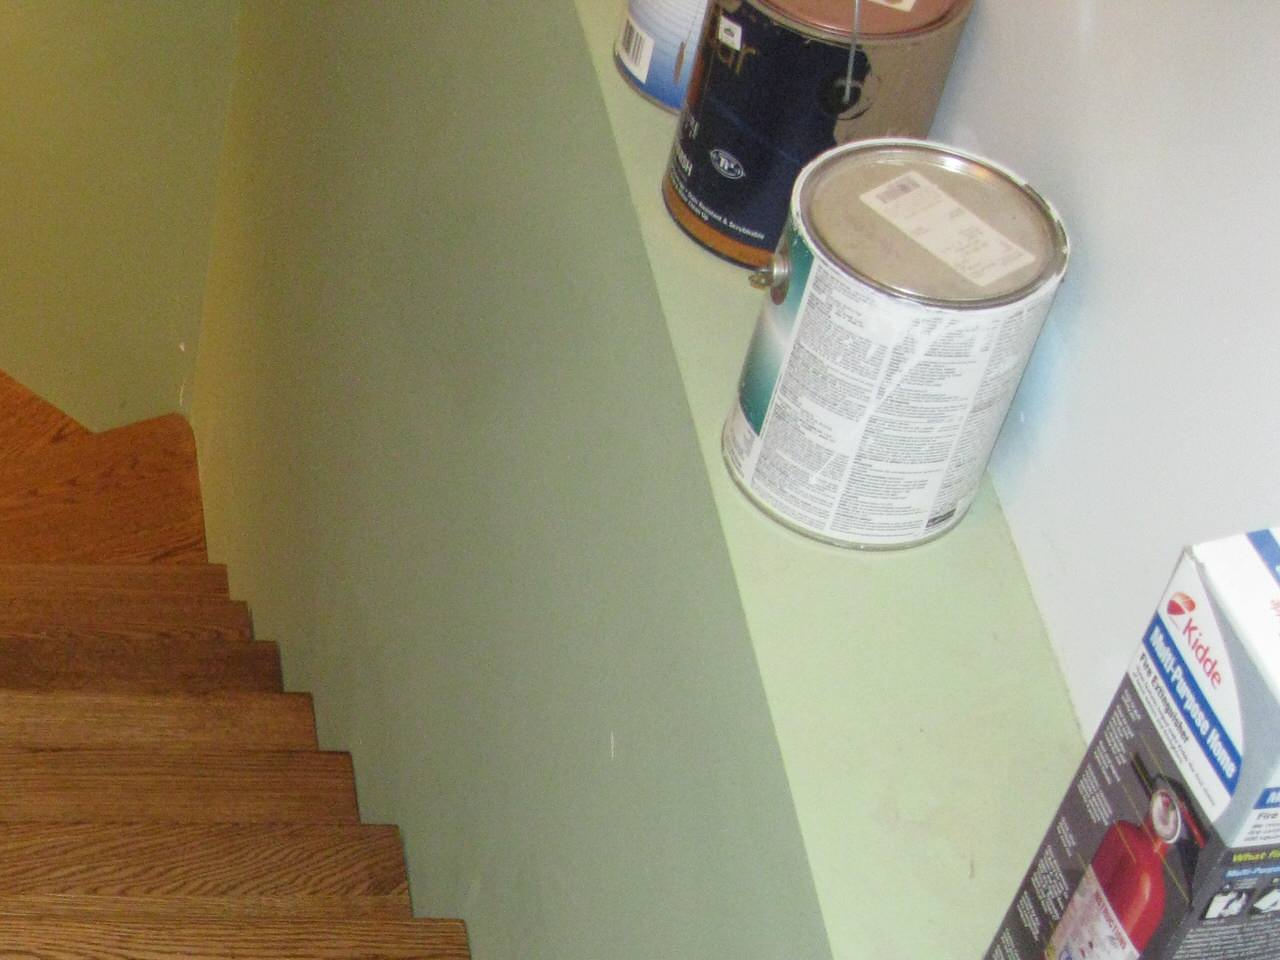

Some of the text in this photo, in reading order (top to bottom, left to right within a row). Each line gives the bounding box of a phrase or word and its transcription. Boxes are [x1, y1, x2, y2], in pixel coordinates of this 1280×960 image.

[1138, 651, 1190, 744] Fire Extinguisher
[1182, 618, 1222, 690] Kidde
[1148, 624, 1210, 737] Multi-Purpose
[1206, 726, 1237, 780] Home
